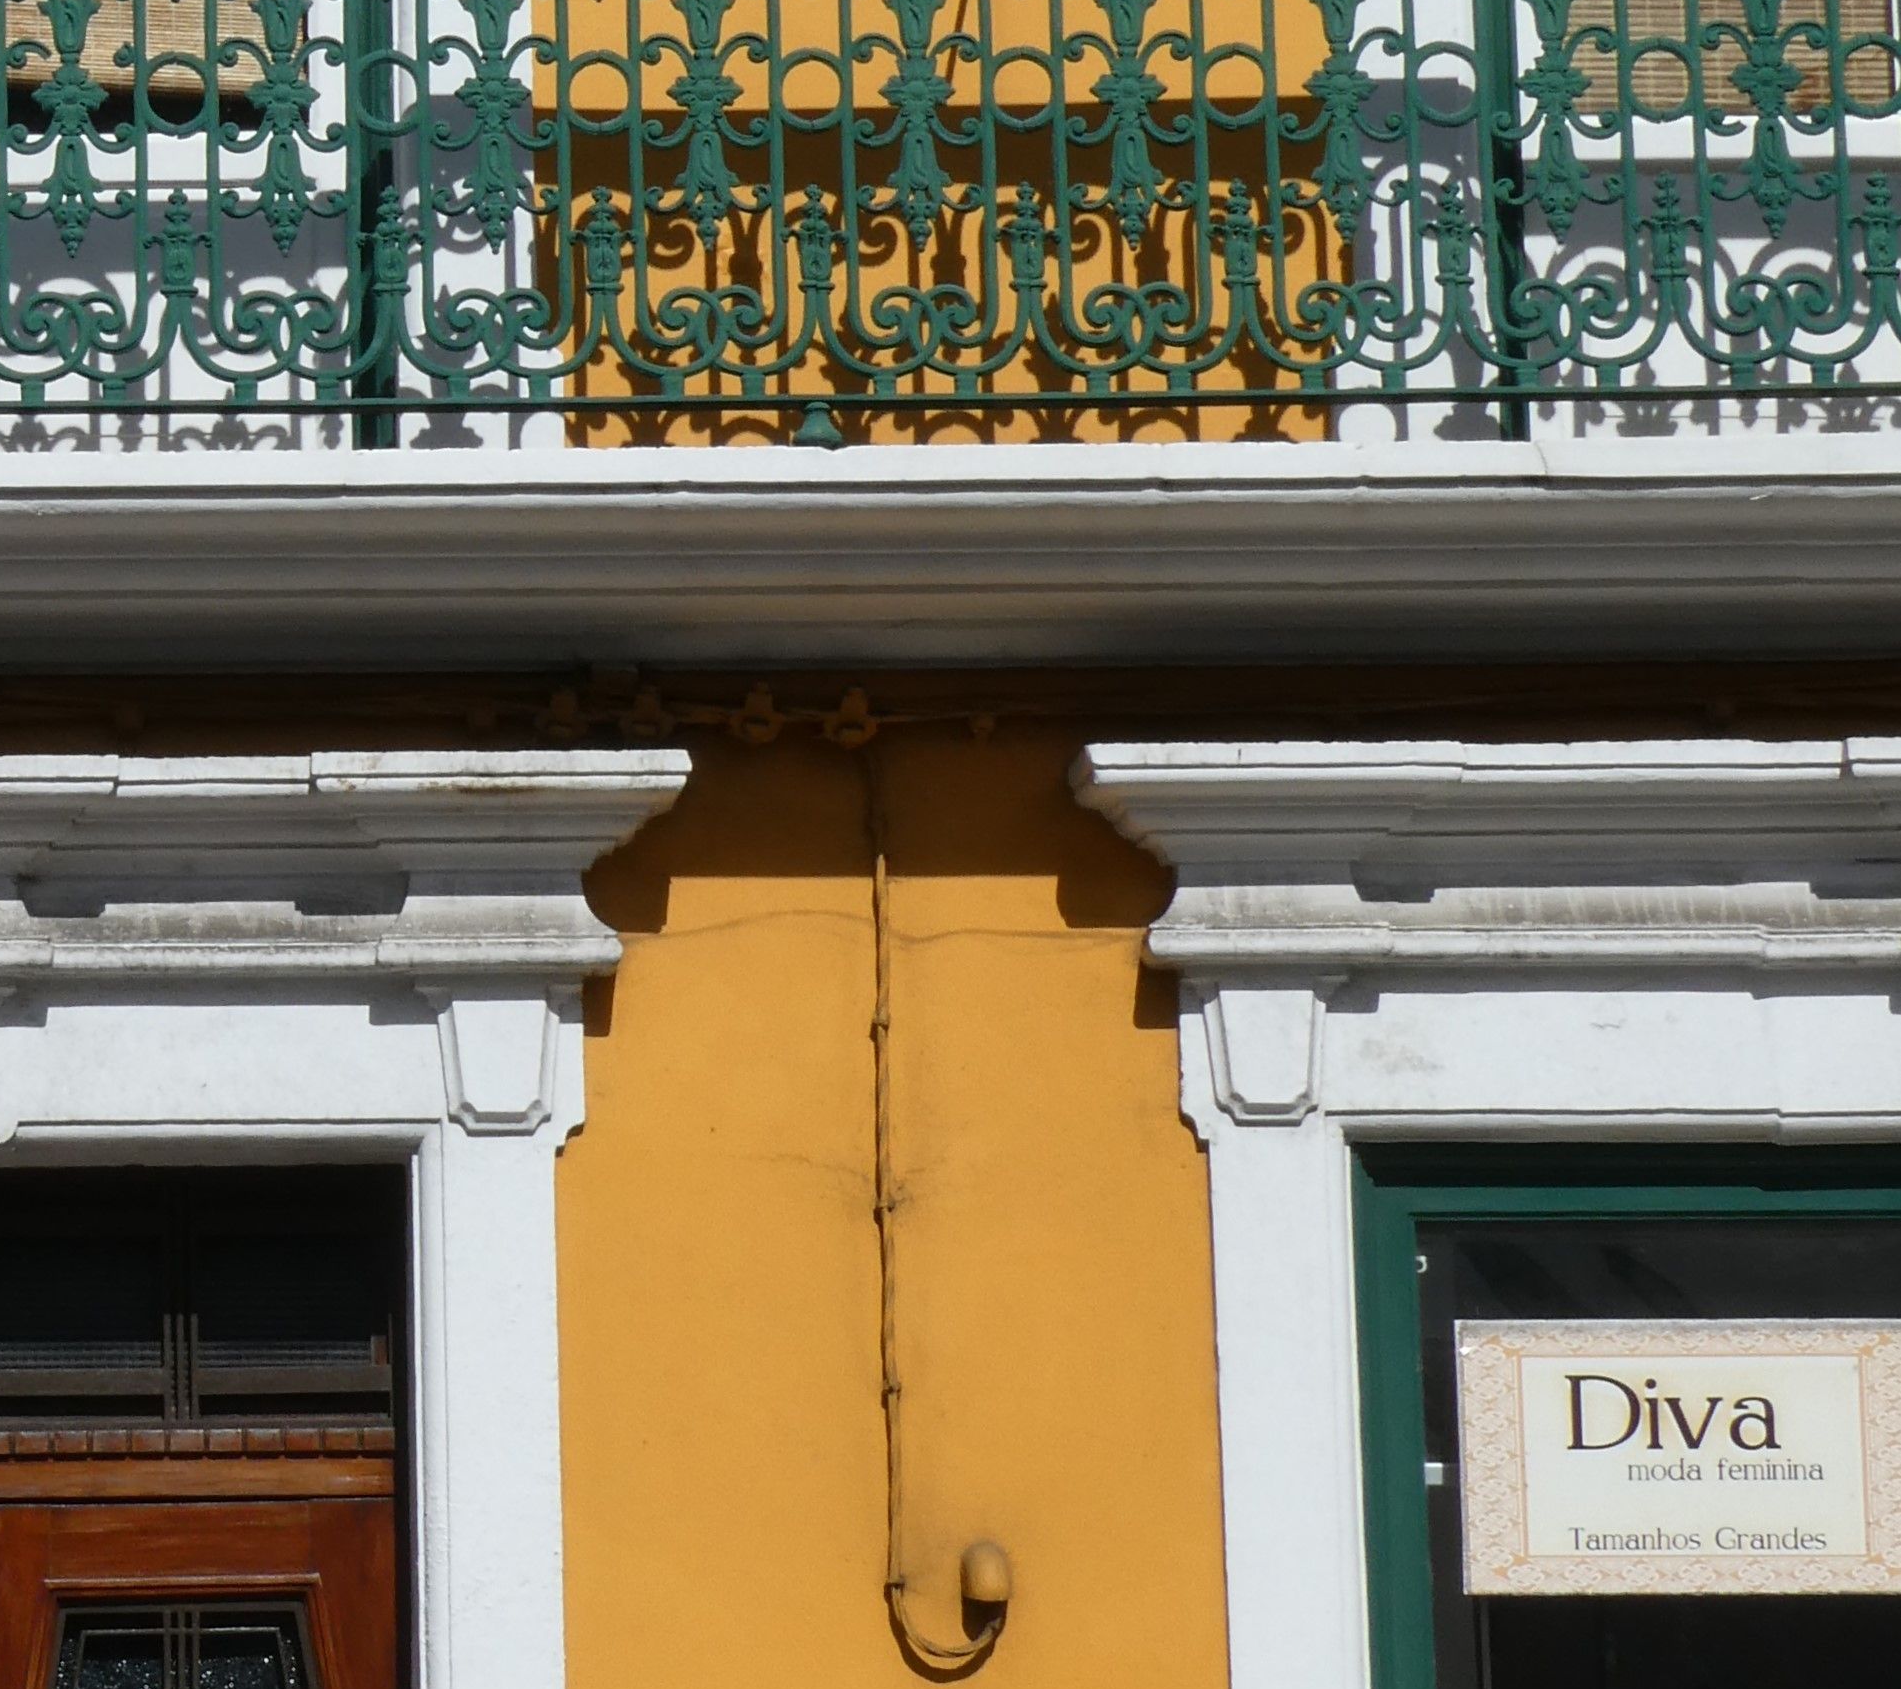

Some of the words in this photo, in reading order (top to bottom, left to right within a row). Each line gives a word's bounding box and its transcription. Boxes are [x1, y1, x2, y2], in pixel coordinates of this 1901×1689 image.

[1564, 1374, 1781, 1451] Diva
[1627, 1458, 1702, 1482] moda
[1716, 1457, 1825, 1482] feminina
[1568, 1527, 1702, 1552] Tamanhos
[1714, 1527, 1827, 1552] Grandes
